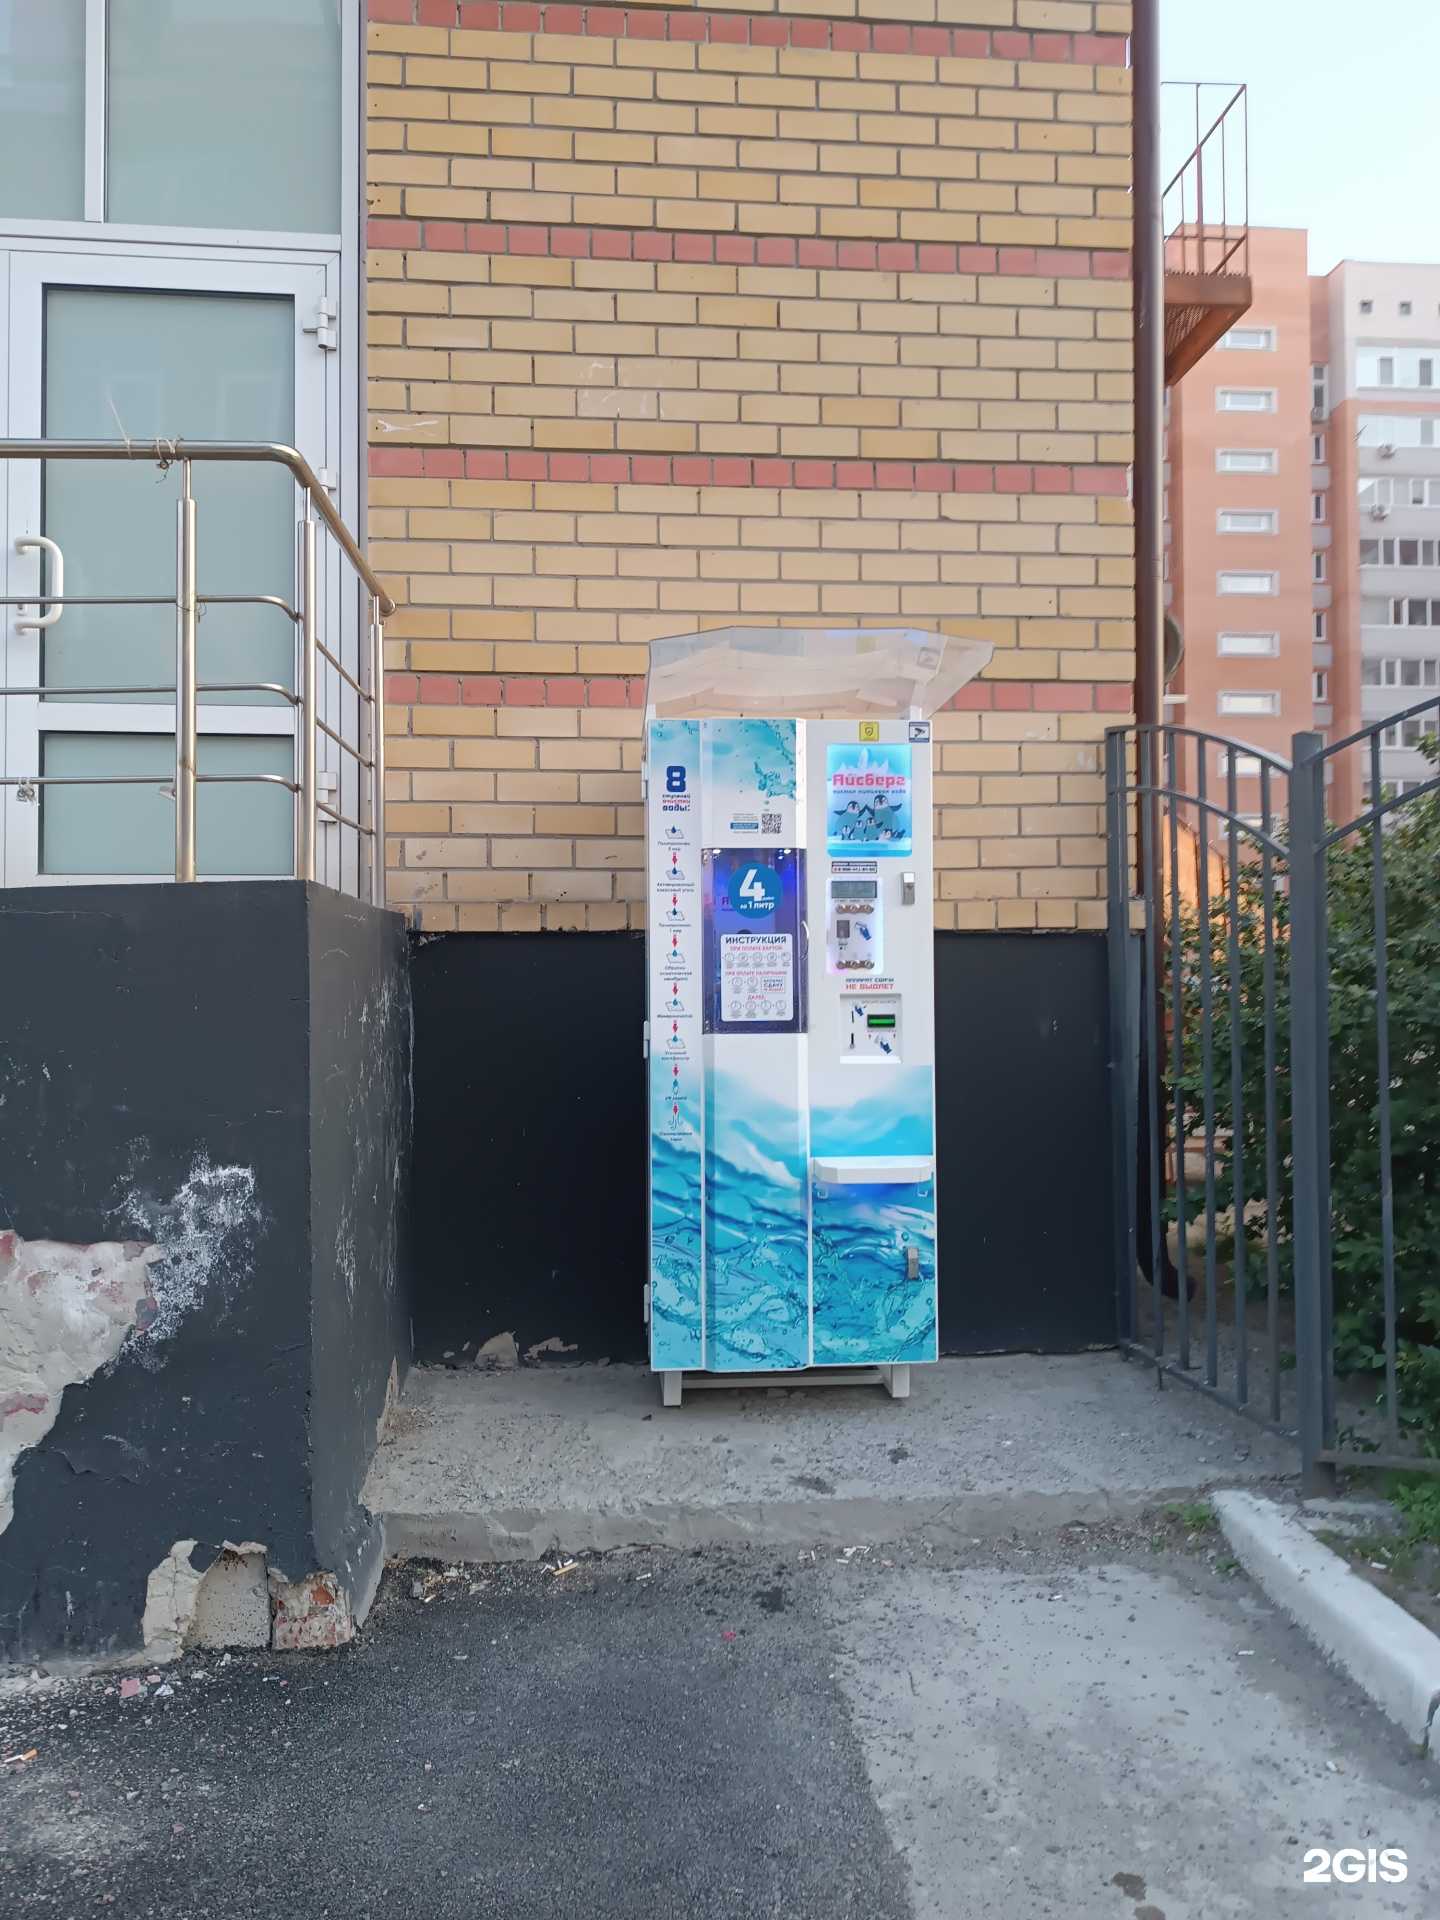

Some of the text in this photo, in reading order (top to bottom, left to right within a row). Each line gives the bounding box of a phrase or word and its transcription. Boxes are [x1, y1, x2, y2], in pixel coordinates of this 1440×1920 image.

[666, 766, 686, 792] 8
[740, 868, 766, 902] 4
[753, 902, 775, 911] литр
[725, 936, 787, 945] ИНСТРУКЦИЯ
